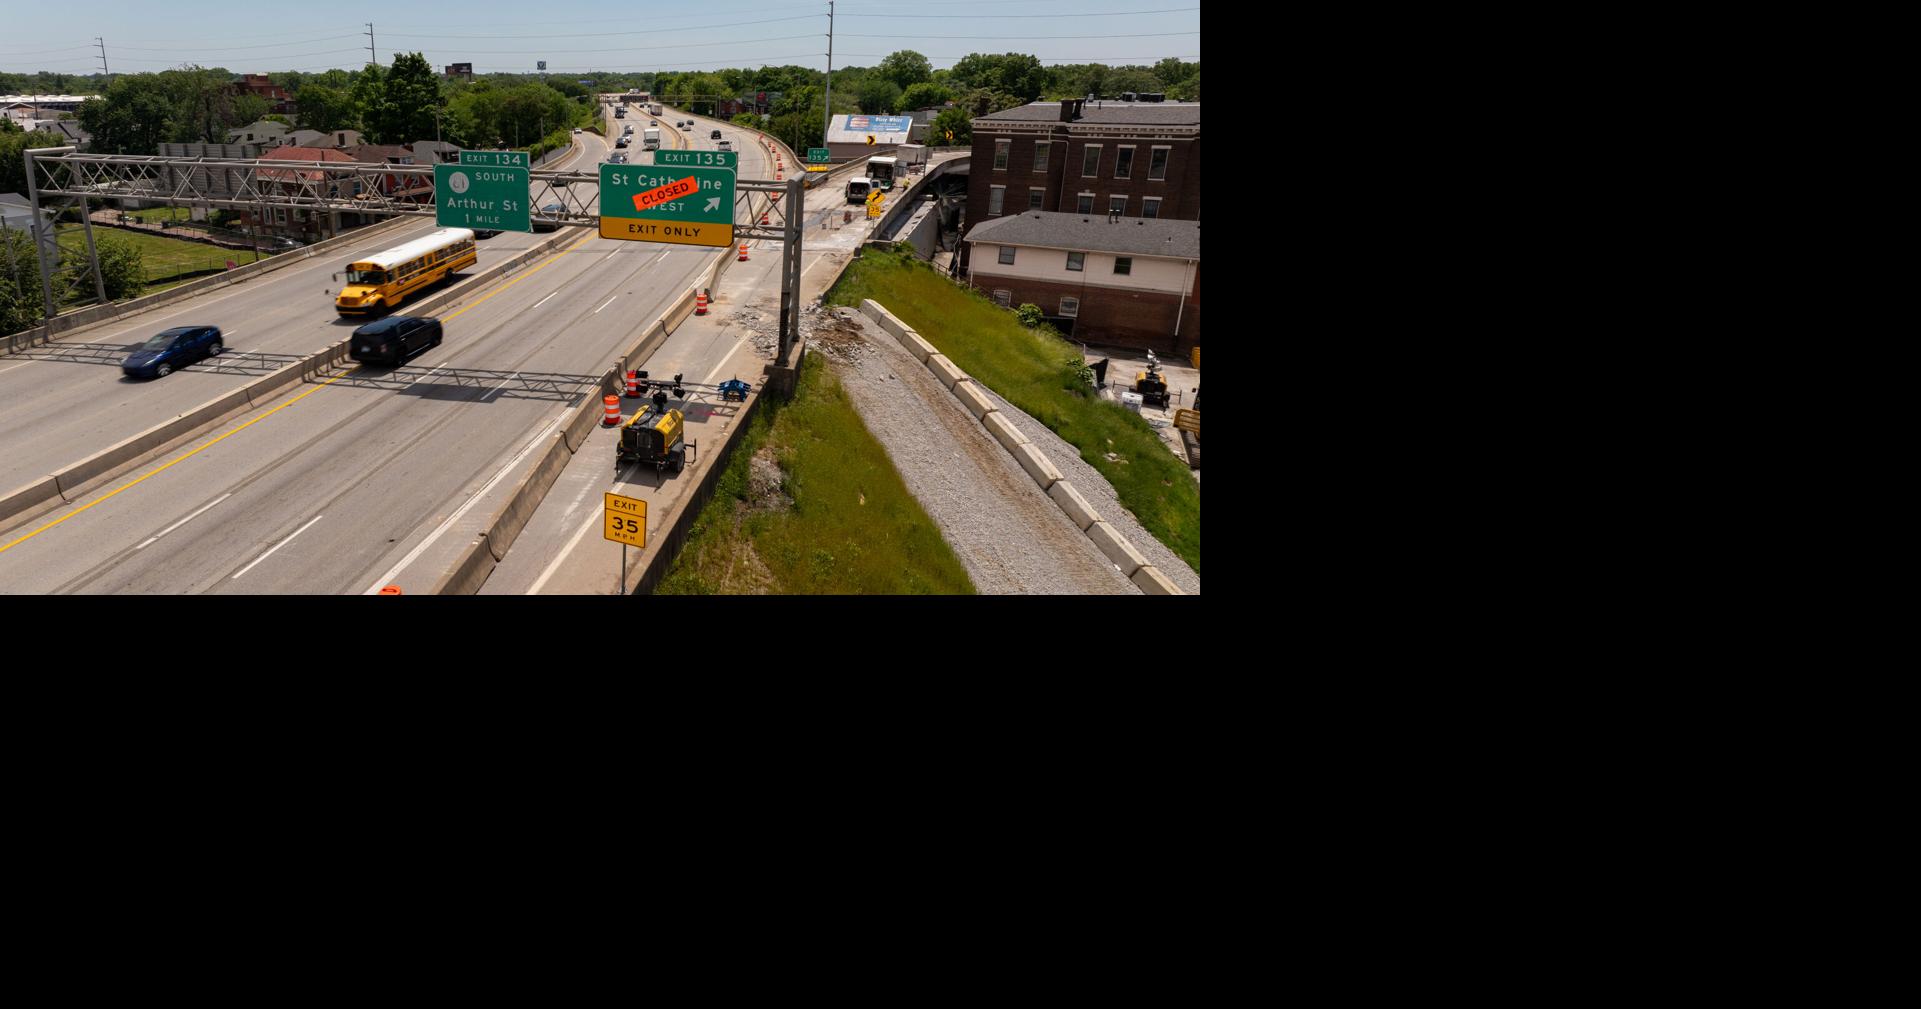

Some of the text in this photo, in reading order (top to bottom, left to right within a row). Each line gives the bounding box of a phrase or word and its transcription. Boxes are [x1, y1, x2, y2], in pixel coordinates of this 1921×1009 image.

[466, 154, 521, 165] EXIT 134
[665, 153, 726, 165] EXIT 135
[475, 171, 514, 182] SOUTH
[612, 173, 722, 190] St Cathine
[641, 182, 690, 206] CLOSED
[447, 197, 518, 211] Arthur St
[465, 213, 500, 224] 1 MILE
[629, 224, 701, 237] EXIT ONLY
[614, 499, 637, 511] EXIT
[612, 517, 638, 533] 35
